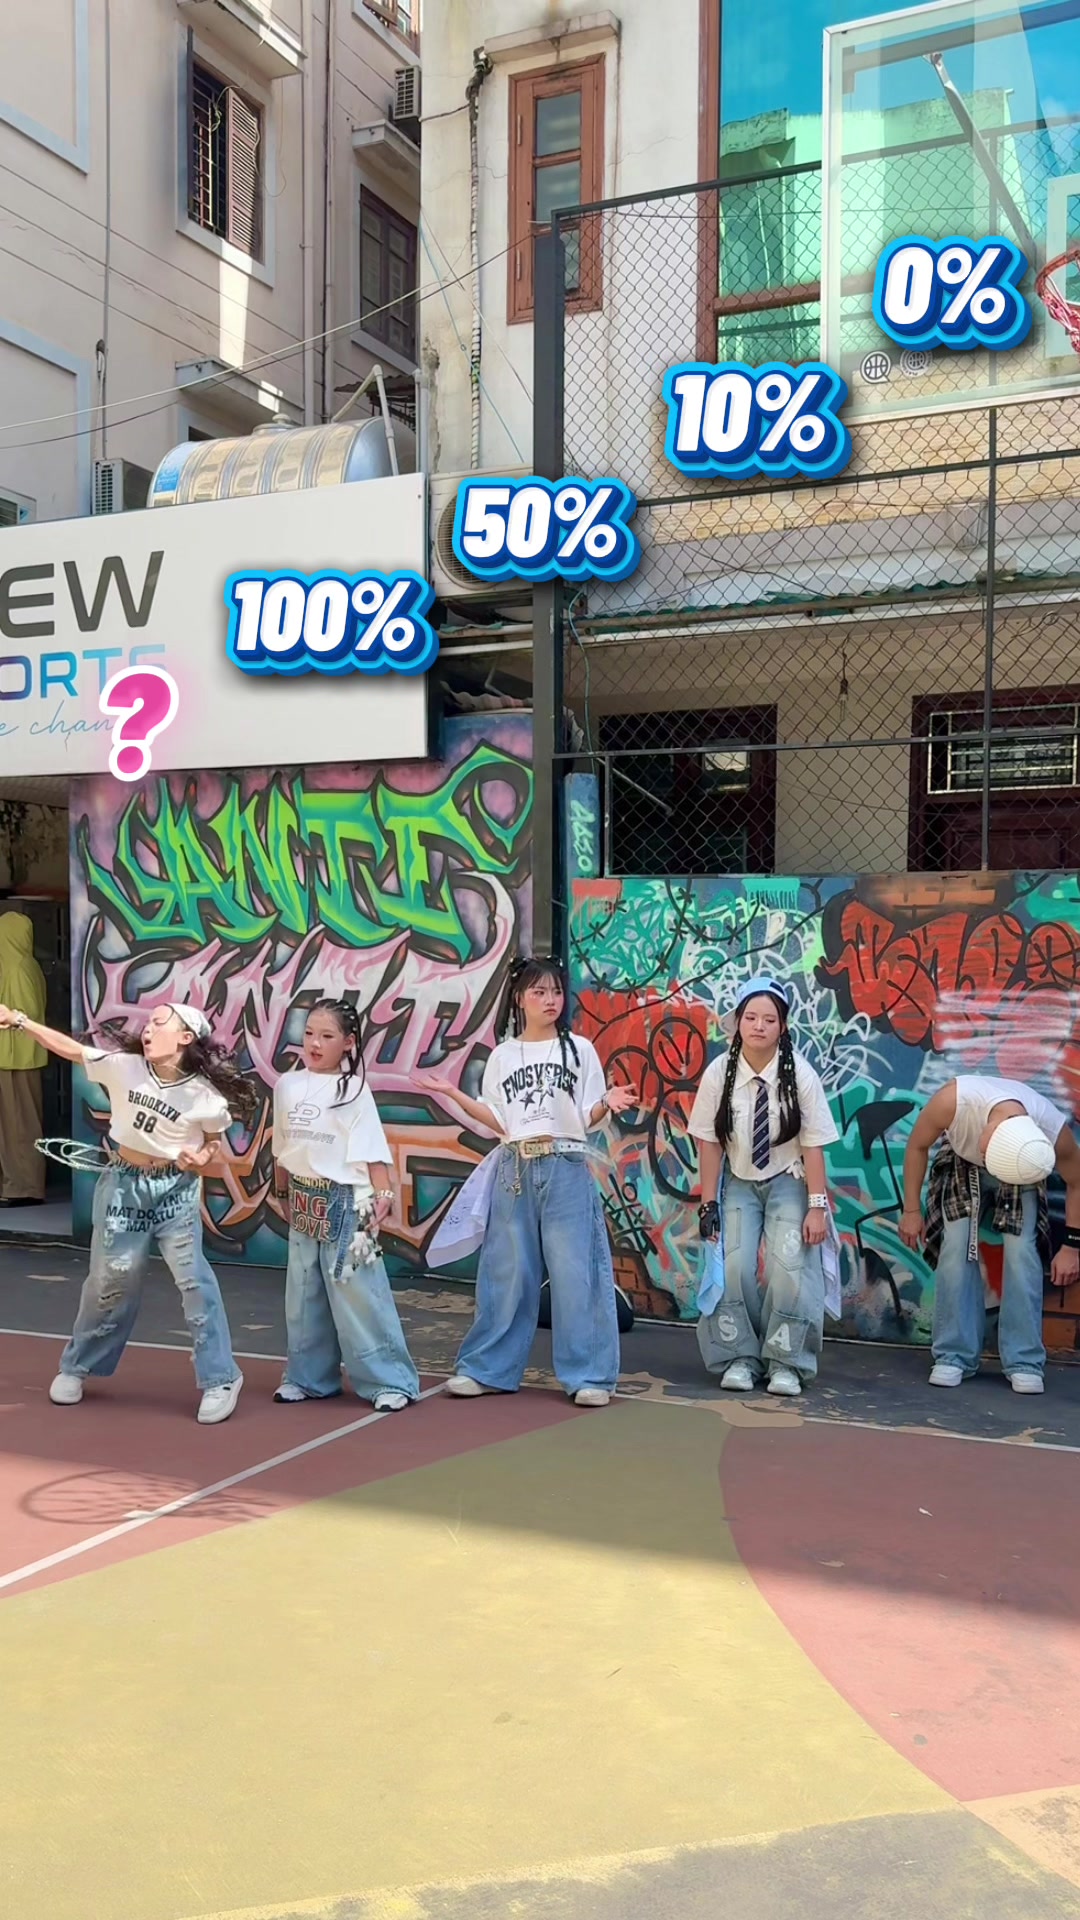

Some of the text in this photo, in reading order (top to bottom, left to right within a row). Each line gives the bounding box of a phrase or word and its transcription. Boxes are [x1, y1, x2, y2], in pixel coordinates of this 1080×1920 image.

[128, 1089, 182, 1123] BROOKLYN
[294, 1175, 332, 1191] UNDRY
[292, 1189, 329, 1219] NG
[292, 1214, 331, 1241] OVE
[718, 1314, 739, 1342] S
[767, 1322, 792, 1352] A
